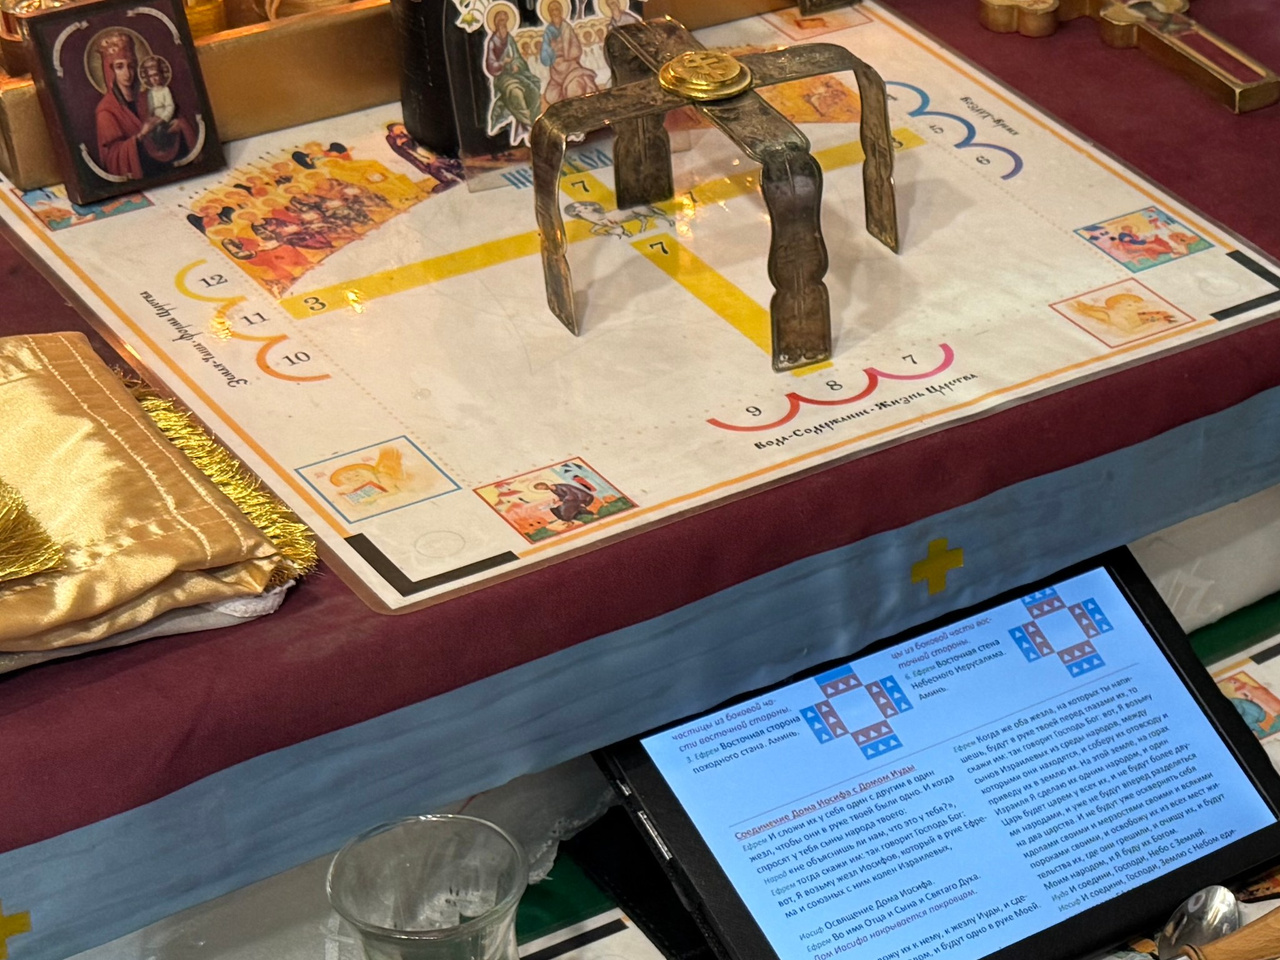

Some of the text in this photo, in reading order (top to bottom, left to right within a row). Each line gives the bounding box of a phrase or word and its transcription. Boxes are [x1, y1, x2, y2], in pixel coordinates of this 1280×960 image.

[571, 180, 590, 193] 7
[649, 241, 669, 255] 7
[199, 273, 229, 289] 12
[303, 296, 327, 311] 3
[241, 312, 271, 326] 11
[282, 350, 312, 367] 10
[825, 379, 843, 392] 8
[901, 353, 918, 365] 7
[745, 405, 763, 418] 9
[692, 730, 800, 774] походного стана. Аминь.
[718, 728, 765, 750] Восточная
[765, 715, 801, 733] сторона
[973, 708, 1148, 784] сынов Израилевых из среды народов, между
[767, 832, 777, 841] И
[776, 821, 806, 837] сложи
[805, 817, 818, 825] их
[817, 814, 824, 822] у
[823, 805, 845, 818] себя
[845, 796, 869, 810] один
[874, 781, 907, 799] другим
[912, 769, 935, 783] один
[993, 796, 1030, 816] Израиля
[1028, 793, 1036, 801] Я
[1036, 781, 1067, 798] сделаю
[1066, 777, 1078, 785] их
[1077, 765, 1105, 781] одним
[1104, 750, 1143, 769] народом,
[1148, 738, 1169, 751] один
[756, 808, 907, 874] спросят у тебя сыны народа твоего:
[787, 863, 805, 874] «не
[804, 843, 855, 867] объяснишь
[854, 838, 867, 847] ли
[867, 829, 889, 842] нам,
[887, 822, 904, 832] что
[902, 816, 919, 827] это
[923, 801, 956, 818] тебя?»,
[795, 871, 821, 886] тогда
[820, 860, 848, 875] скажи
[848, 852, 865, 863] им:
[864, 846, 881, 856] так
[880, 832, 914, 851] говорит
[912, 818, 949, 836] Господь
[946, 810, 966, 822] Бог:
[1042, 874, 1070, 890] Моим
[1069, 858, 1109, 879] народом,
[1113, 850, 1122, 859] Я
[1120, 842, 1141, 856] буду
[1140, 839, 1152, 847] их
[1150, 827, 1178, 843] Богом.
[1068, 884, 1077, 893] И
[1076, 870, 1115, 890] соедини,
[1112, 854, 1149, 874] Господи,
[1146, 844, 1170, 858] Небо
[1173, 827, 1207, 846] Землей.
[784, 908, 798, 918] ма
[805, 888, 845, 909] союзных
[851, 877, 871, 889] ним
[871, 866, 898, 881] колен
[896, 843, 953, 871] Израилевых,
[823, 903, 874, 930] Освящение
[873, 893, 900, 910] Дома
[898, 878, 935, 898] Иосифа.
[830, 930, 845, 941] Во
[844, 923, 864, 935] имя
[863, 913, 887, 927] Отца
[893, 899, 918, 914] Сына
[923, 882, 958, 901] Святаго
[957, 872, 980, 888] Духа.
[832, 934, 869, 954] Иосифа
[868, 909, 928, 939] накрывается
[927, 888, 978, 913] покровцом.
[900, 945, 912, 954] их
[918, 931, 944, 946] нему,
[949, 916, 977, 932] жезлу
[975, 905, 1004, 920] Иуды,
[1009, 894, 1028, 906] сде-
